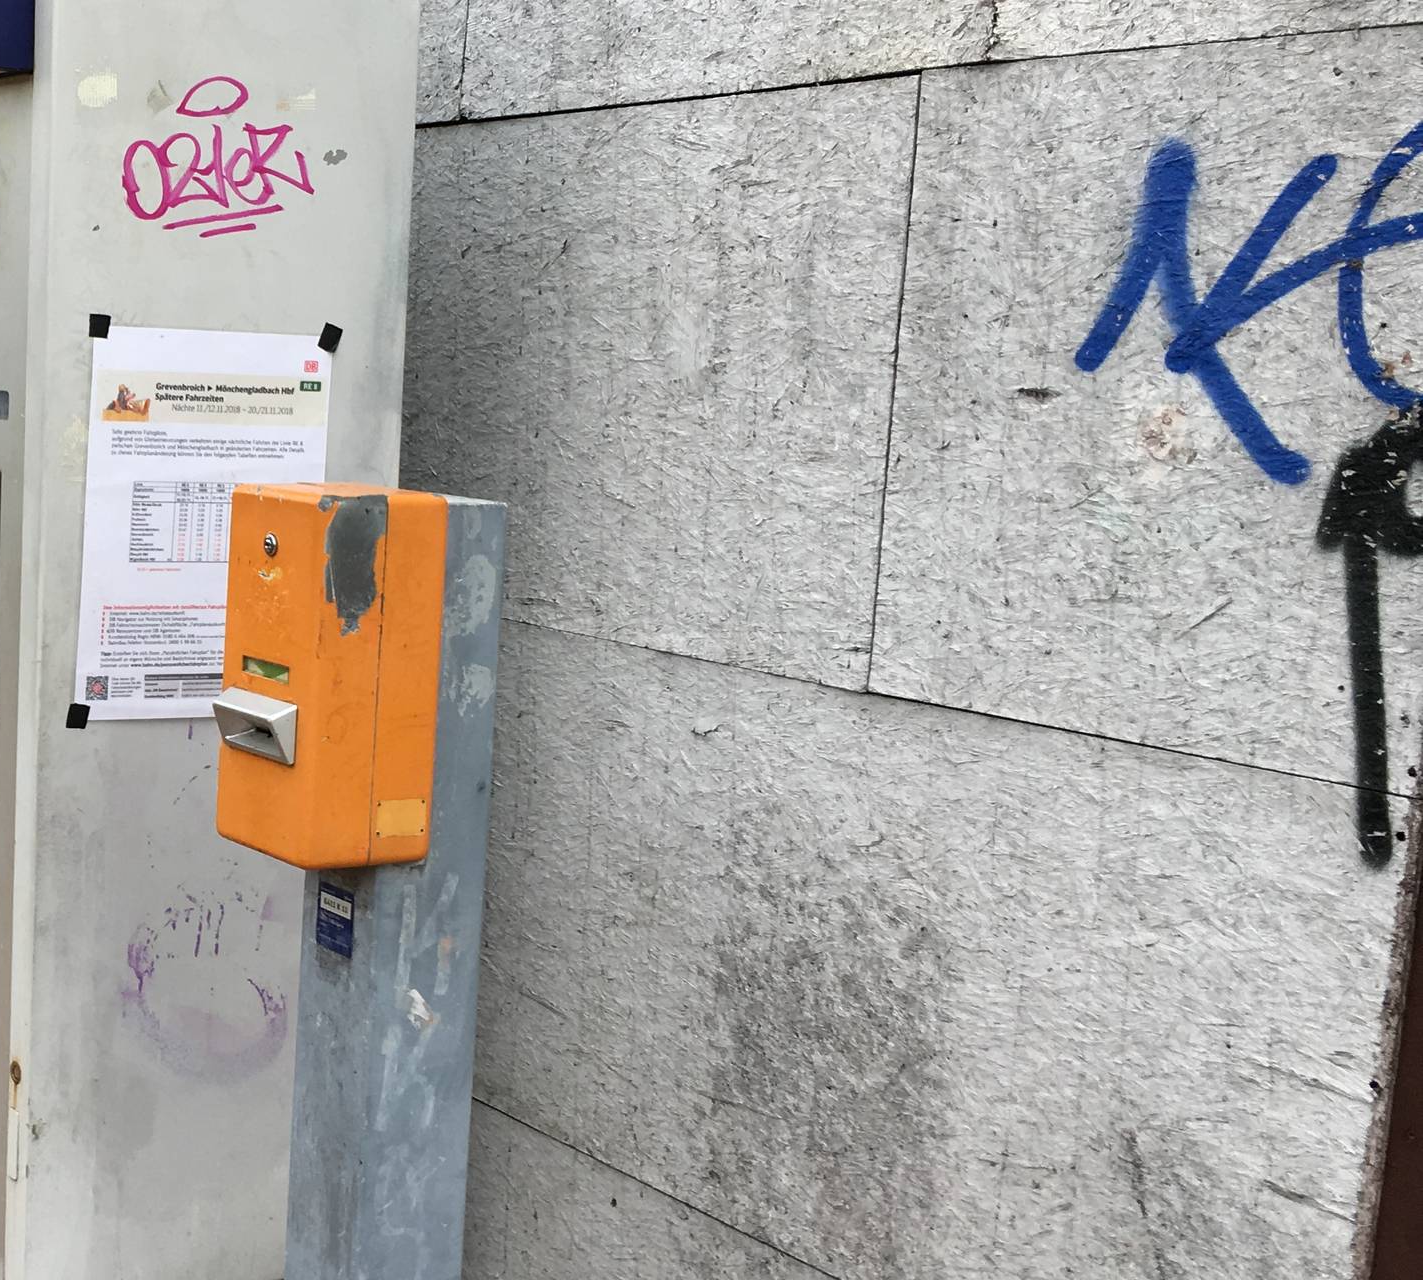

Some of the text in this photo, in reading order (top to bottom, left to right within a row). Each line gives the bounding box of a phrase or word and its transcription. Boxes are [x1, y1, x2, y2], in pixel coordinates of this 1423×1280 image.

[155, 382, 295, 396] Grevenbroich Mönchengladbach Hbf
[155, 392, 224, 403] Spätere Fahrzeiten
